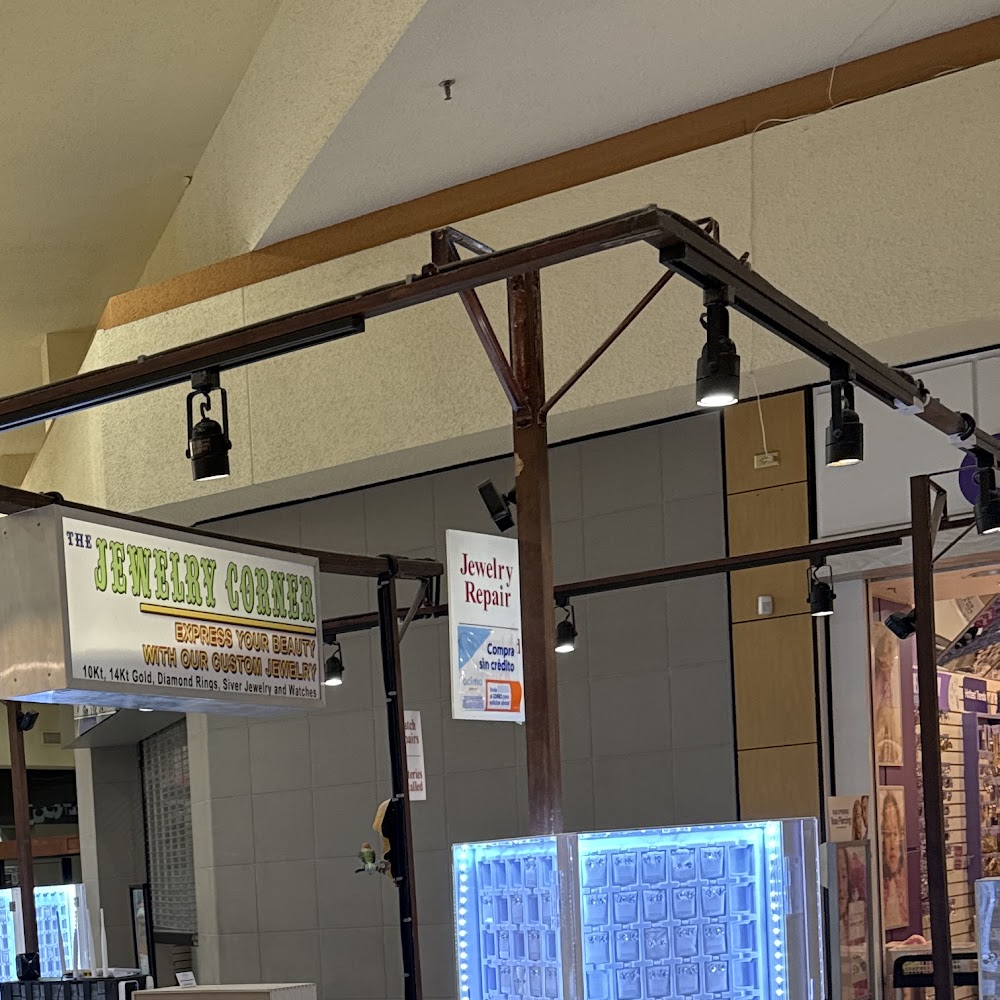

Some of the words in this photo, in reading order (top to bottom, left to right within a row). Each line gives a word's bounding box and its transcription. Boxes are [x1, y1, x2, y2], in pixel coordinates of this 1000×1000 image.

[66, 531, 92, 549] THE
[94, 537, 217, 608] JEWELRY
[225, 561, 315, 623] CORNER
[460, 552, 514, 587] Jewelry
[464, 580, 511, 611] Repair
[174, 621, 233, 649] EXPRESS
[235, 630, 269, 654] YOUR
[272, 634, 316, 659] BEAUTY
[487, 643, 515, 658] Compra
[142, 644, 178, 668] WITH
[180, 651, 209, 672] OUR
[212, 655, 263, 677] CUSTOM
[265, 659, 317, 682] JEWELRY
[479, 658, 490, 670] sin
[491, 659, 515, 672] crédito
[109, 667, 130, 682] 14Kt
[132, 669, 155, 686] Gold,
[157, 673, 193, 688] Diamond
[195, 676, 221, 691] Rings,
[244, 681, 272, 696] Jewelry
[274, 683, 287, 695] and
[288, 684, 317, 698] Watches
